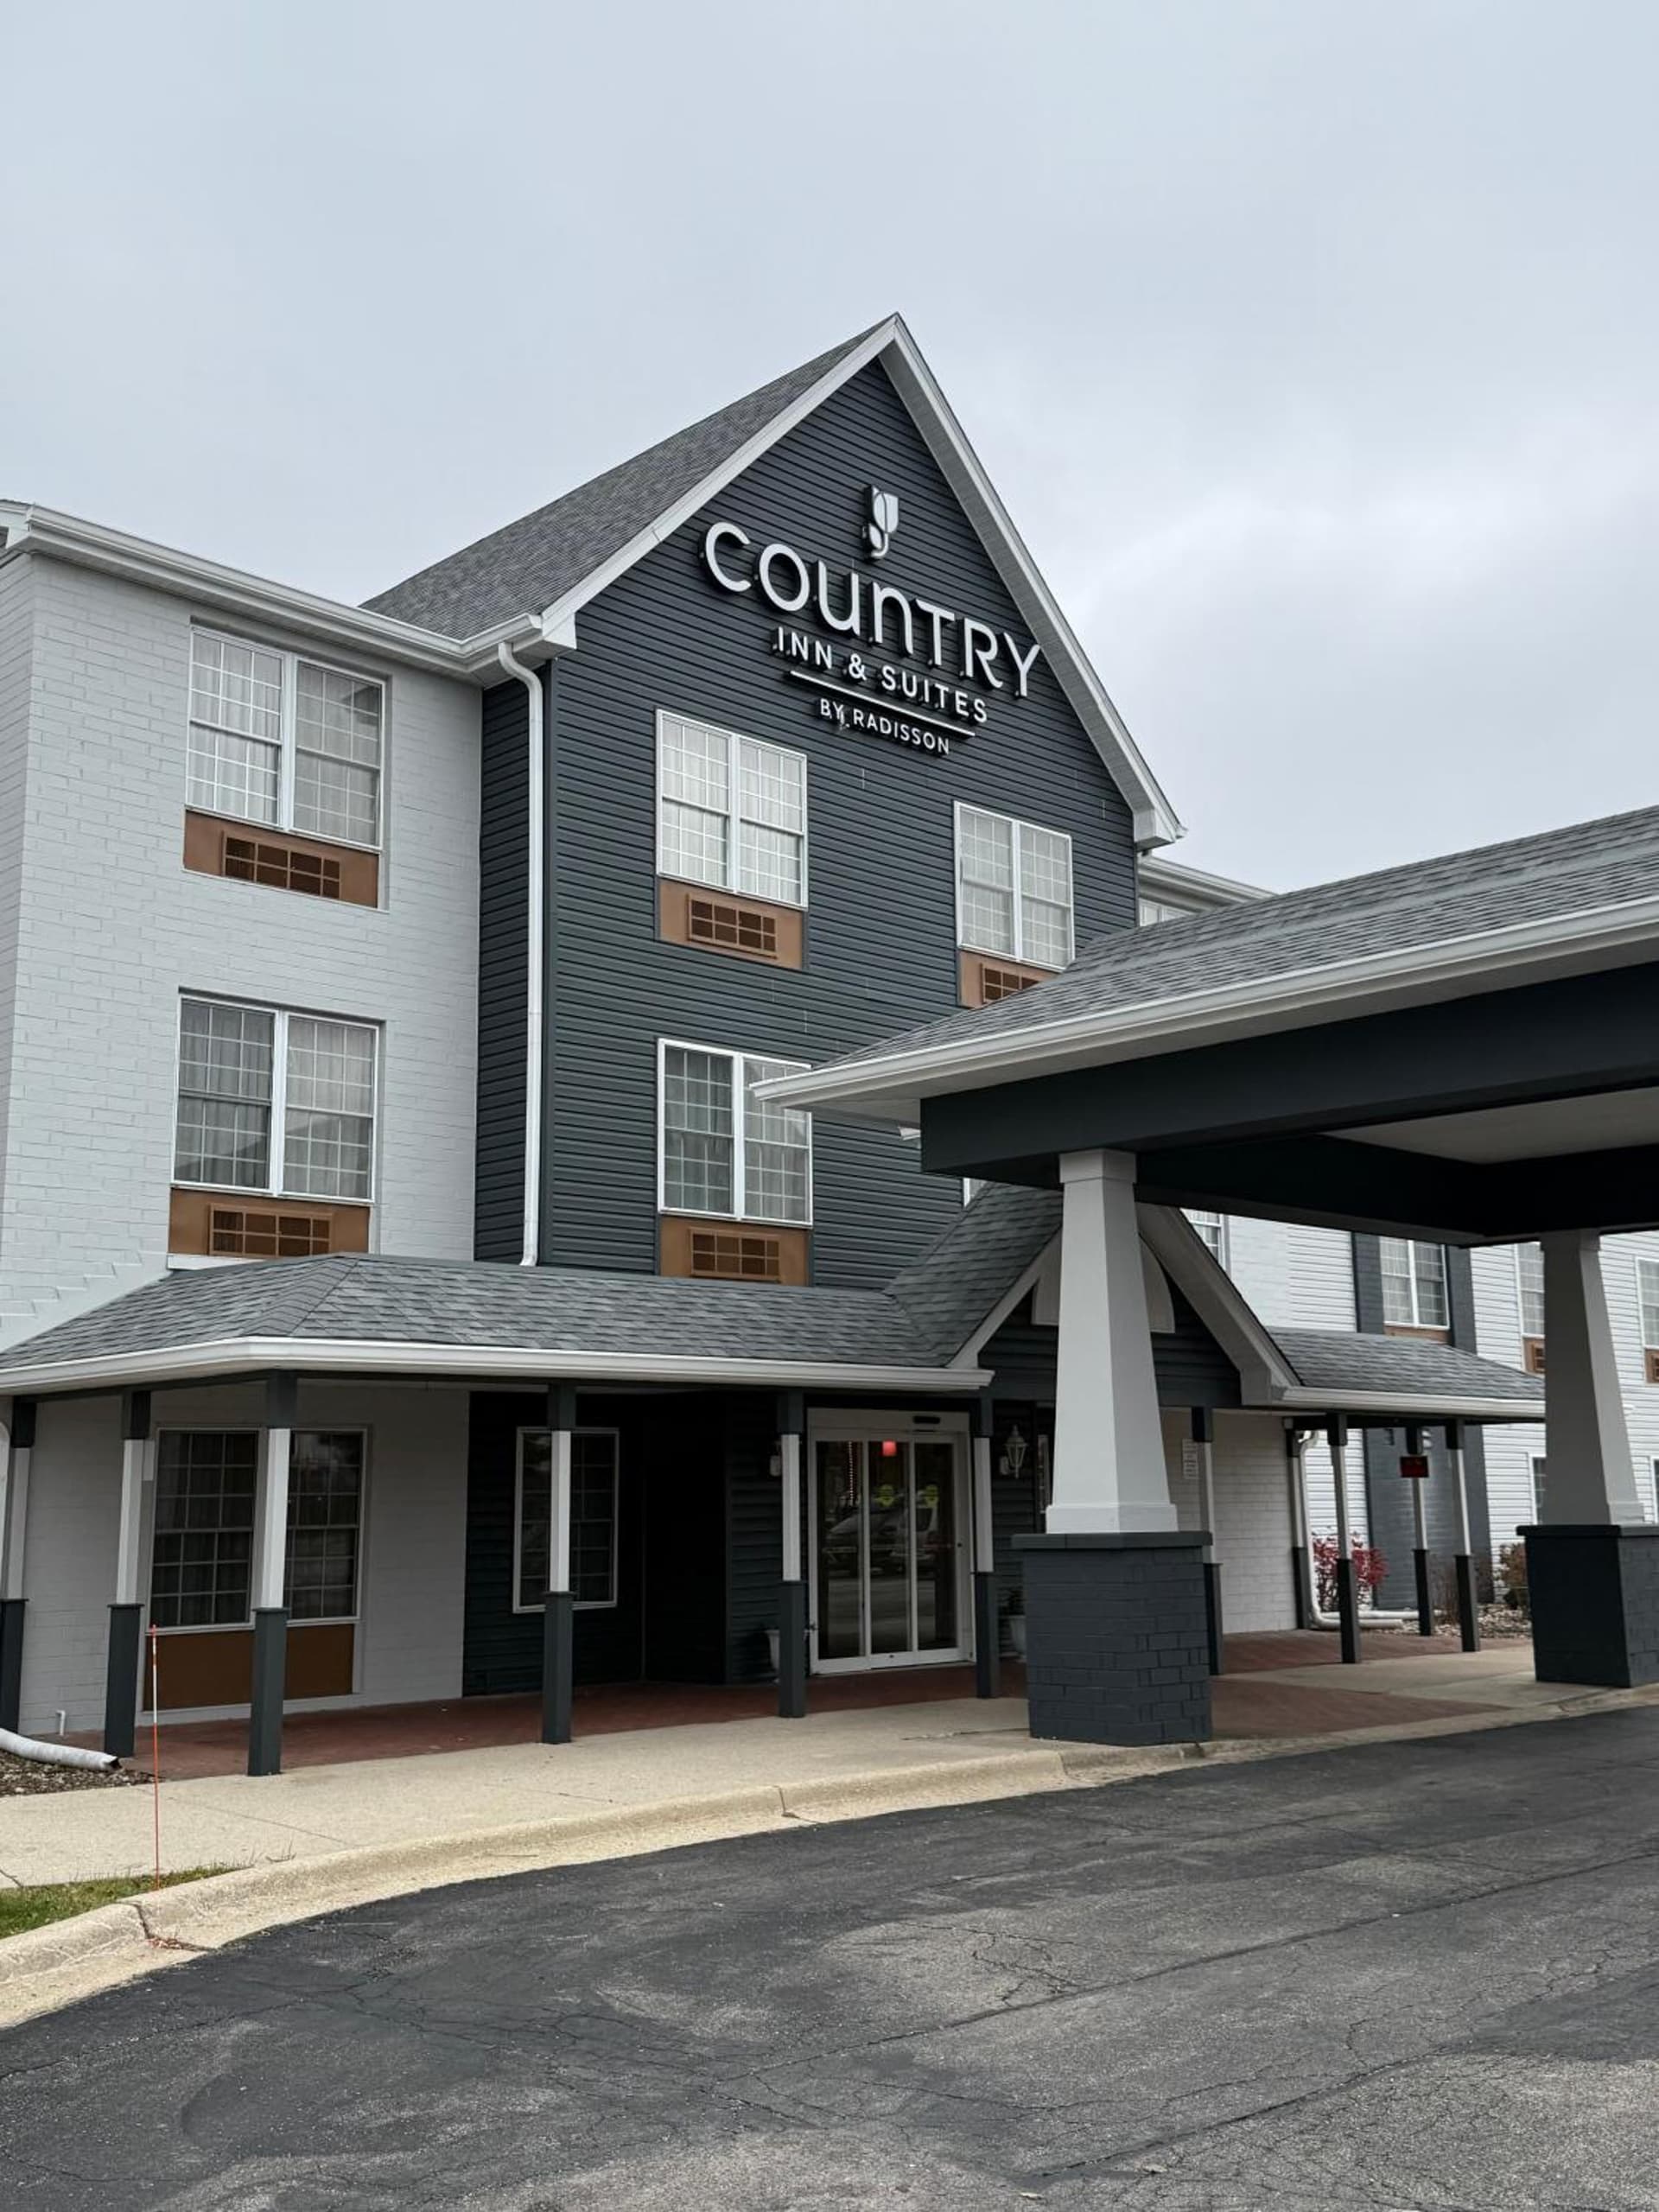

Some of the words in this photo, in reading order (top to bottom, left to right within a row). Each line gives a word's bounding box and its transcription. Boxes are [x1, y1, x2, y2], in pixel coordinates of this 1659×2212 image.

[778, 626, 832, 670] INN
[848, 652, 868, 681] &
[880, 664, 988, 723] SUITES
[820, 698, 844, 722] BY
[852, 708, 950, 755] RADISSON
